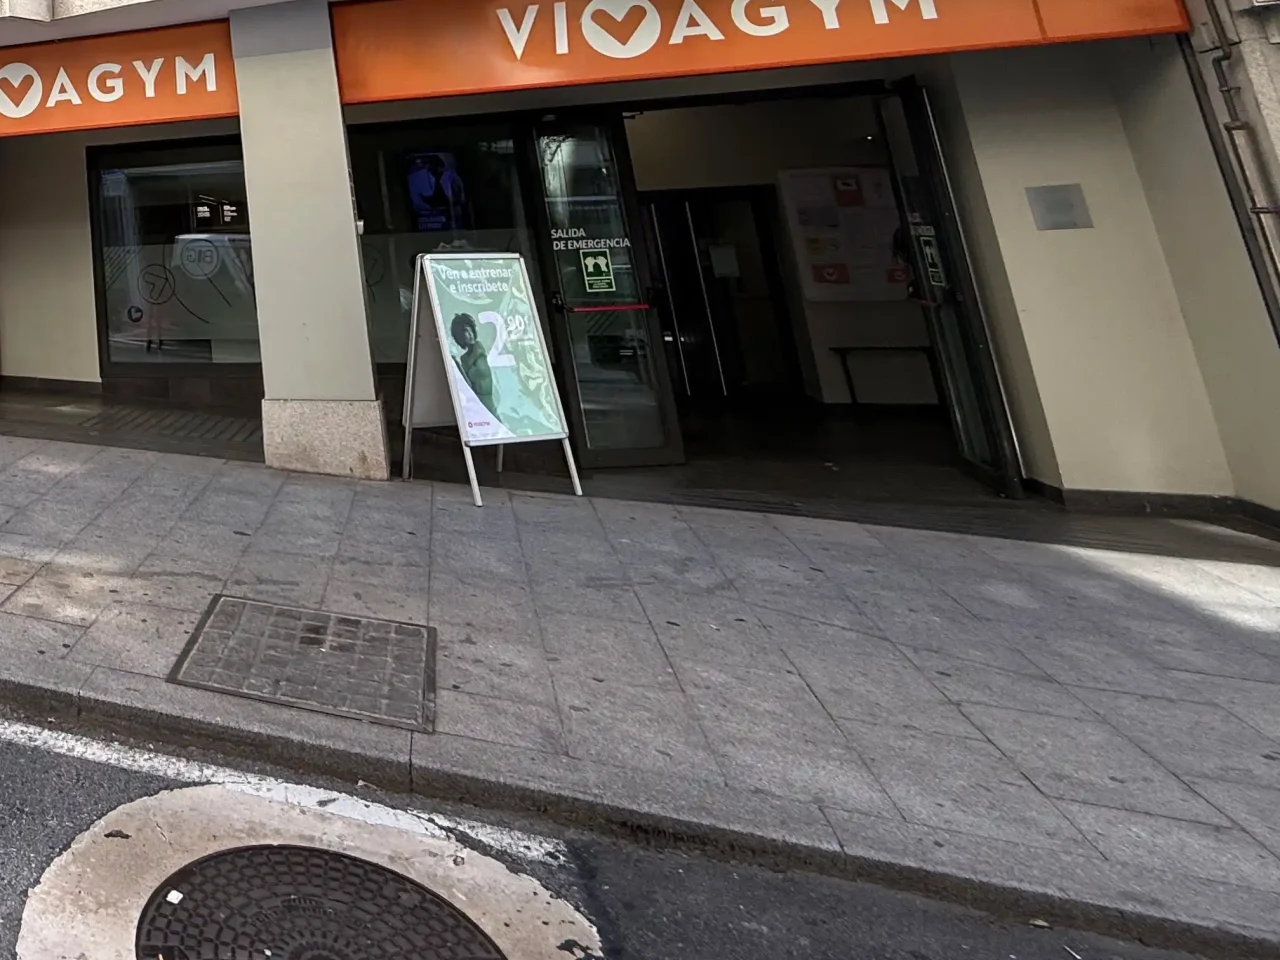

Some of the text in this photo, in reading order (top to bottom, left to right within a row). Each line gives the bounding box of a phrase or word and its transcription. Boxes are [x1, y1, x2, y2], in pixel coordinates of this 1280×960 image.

[551, 228, 586, 239] SALIDA
[553, 238, 631, 250] DE EMERGENCIA
[438, 266, 459, 280] Ven
[469, 267, 513, 279] entrenar
[449, 284, 456, 293] e
